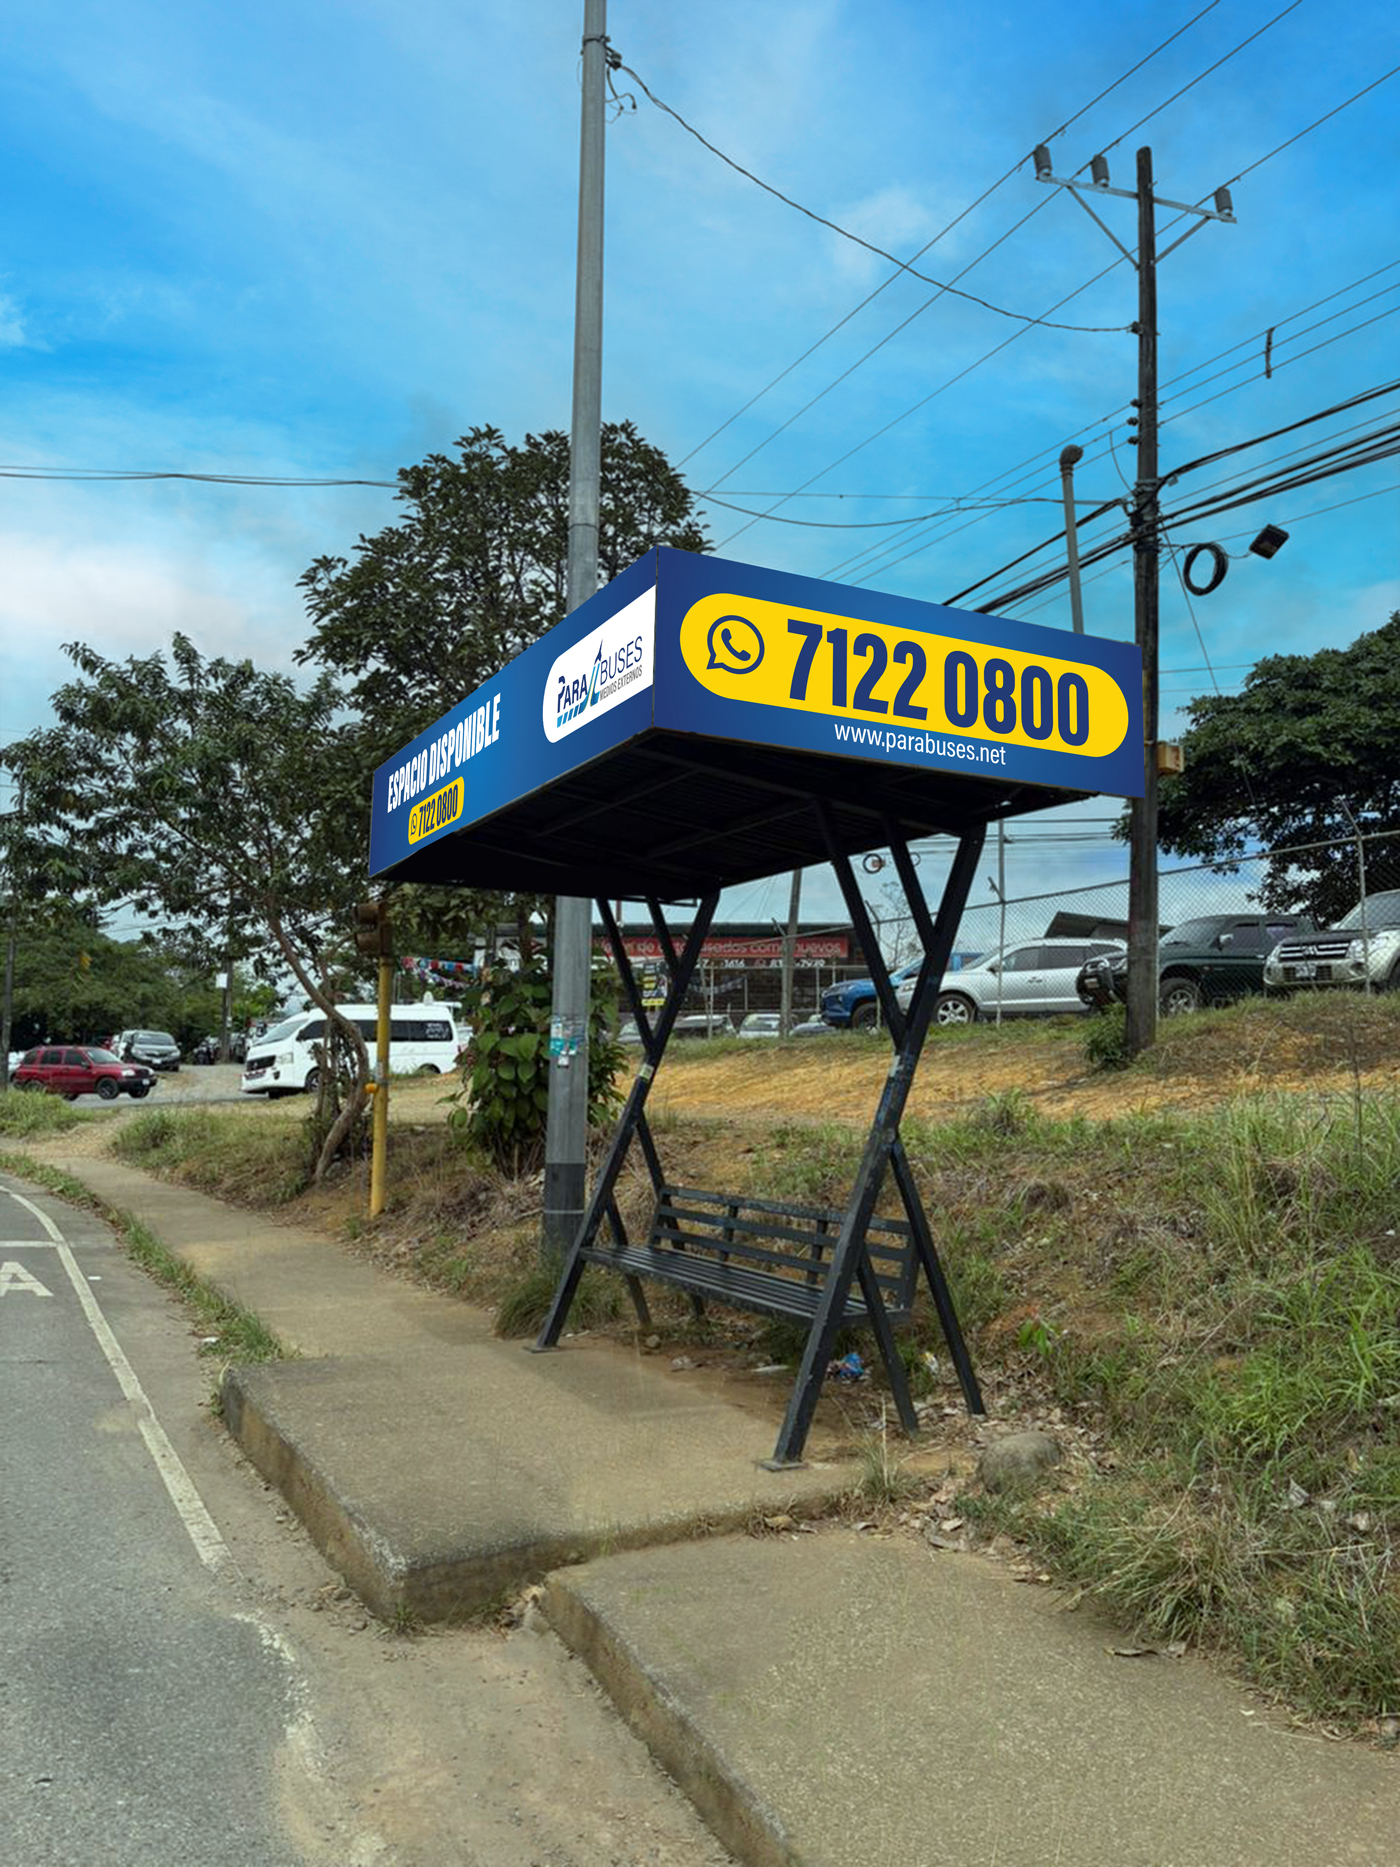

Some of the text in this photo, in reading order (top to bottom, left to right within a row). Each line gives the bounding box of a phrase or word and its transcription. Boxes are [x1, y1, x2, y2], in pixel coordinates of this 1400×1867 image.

[599, 635, 643, 685] BUSES
[599, 664, 642, 701] MEDIOS EXTERNOS
[787, 618, 1089, 747] 7122 0800
[387, 692, 502, 813] ESPACIO DISPONIBLE
[834, 723, 1006, 766] www.parabuses.net
[418, 784, 458, 837] 7122 0800
